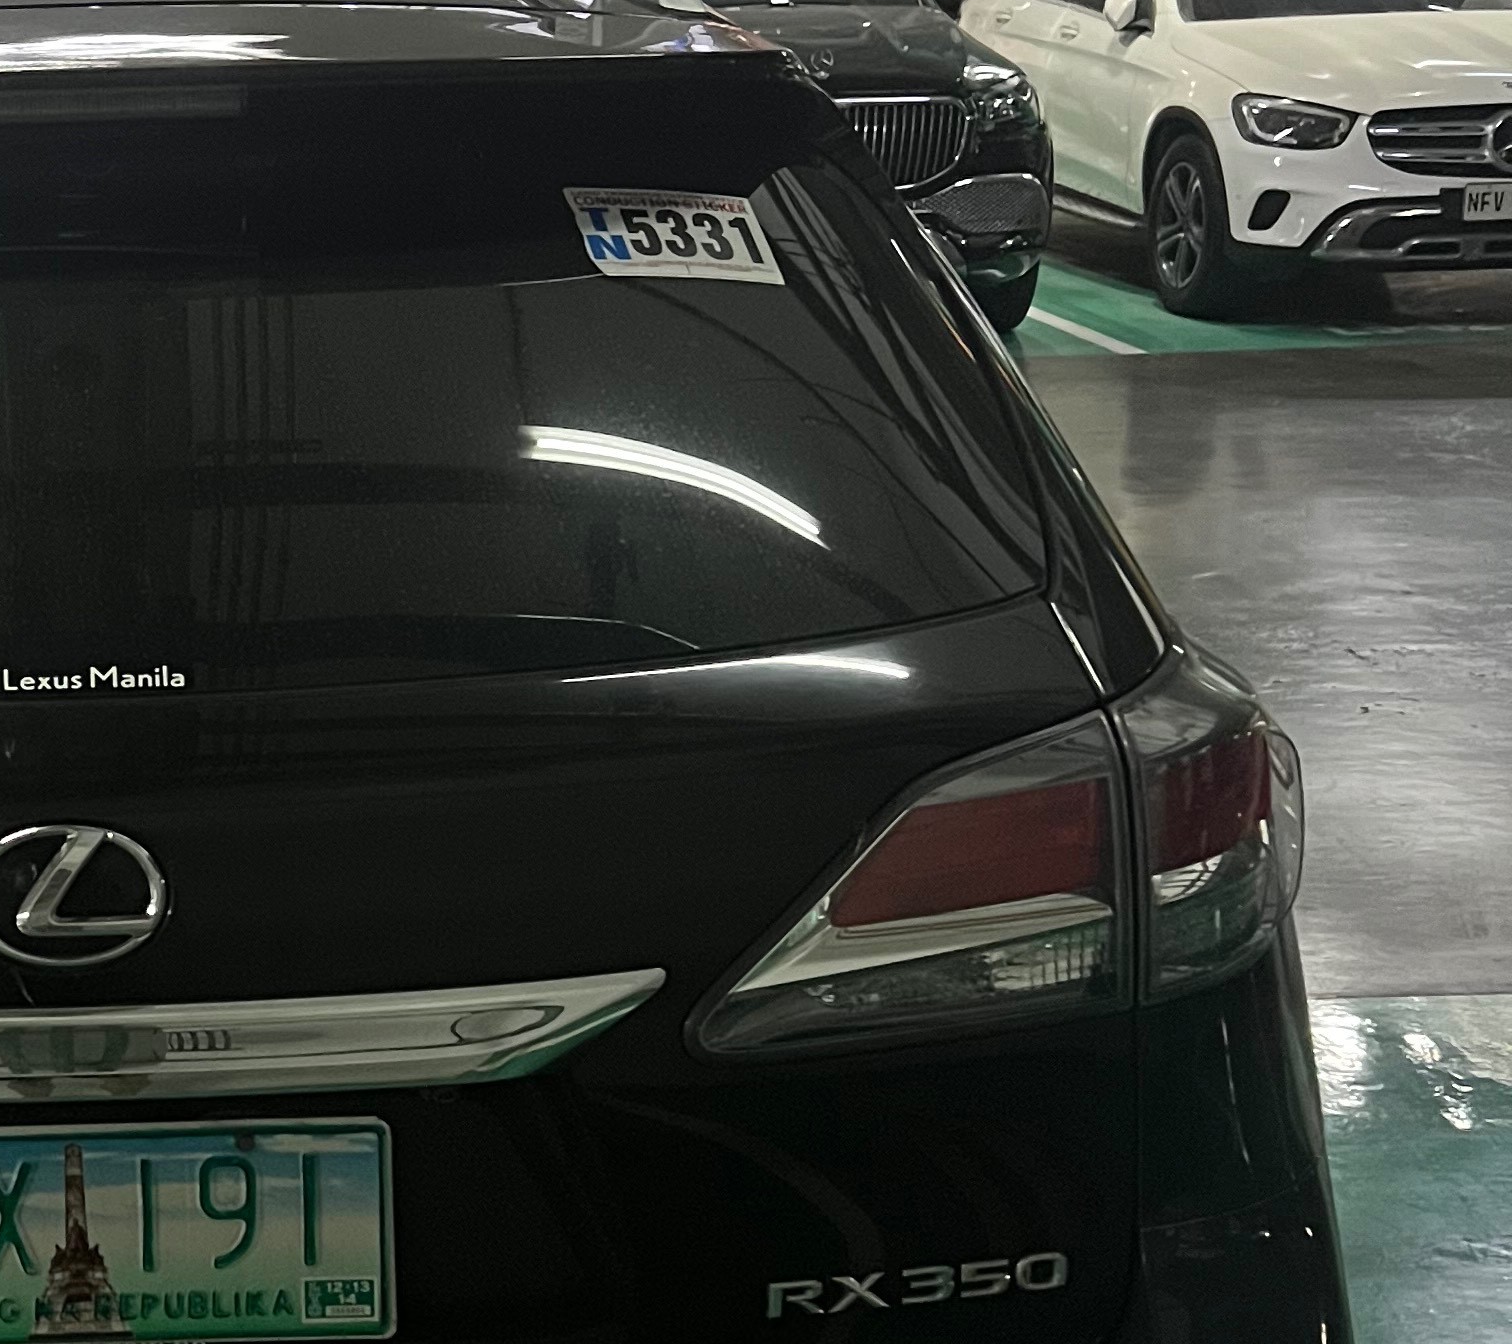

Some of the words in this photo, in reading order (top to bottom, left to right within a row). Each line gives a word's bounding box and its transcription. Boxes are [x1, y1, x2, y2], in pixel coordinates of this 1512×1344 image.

[1467, 191, 1505, 212] NFV
[579, 207, 609, 232] T
[585, 235, 632, 260] N
[619, 208, 764, 265] 5331
[2, 668, 82, 692] Lexus
[89, 665, 186, 689] Manila
[138, 1153, 317, 1273] 191
[765, 1271, 891, 1320] RX
[901, 1251, 1069, 1306] 350
[93, 1289, 295, 1323] REPUBLIKA
